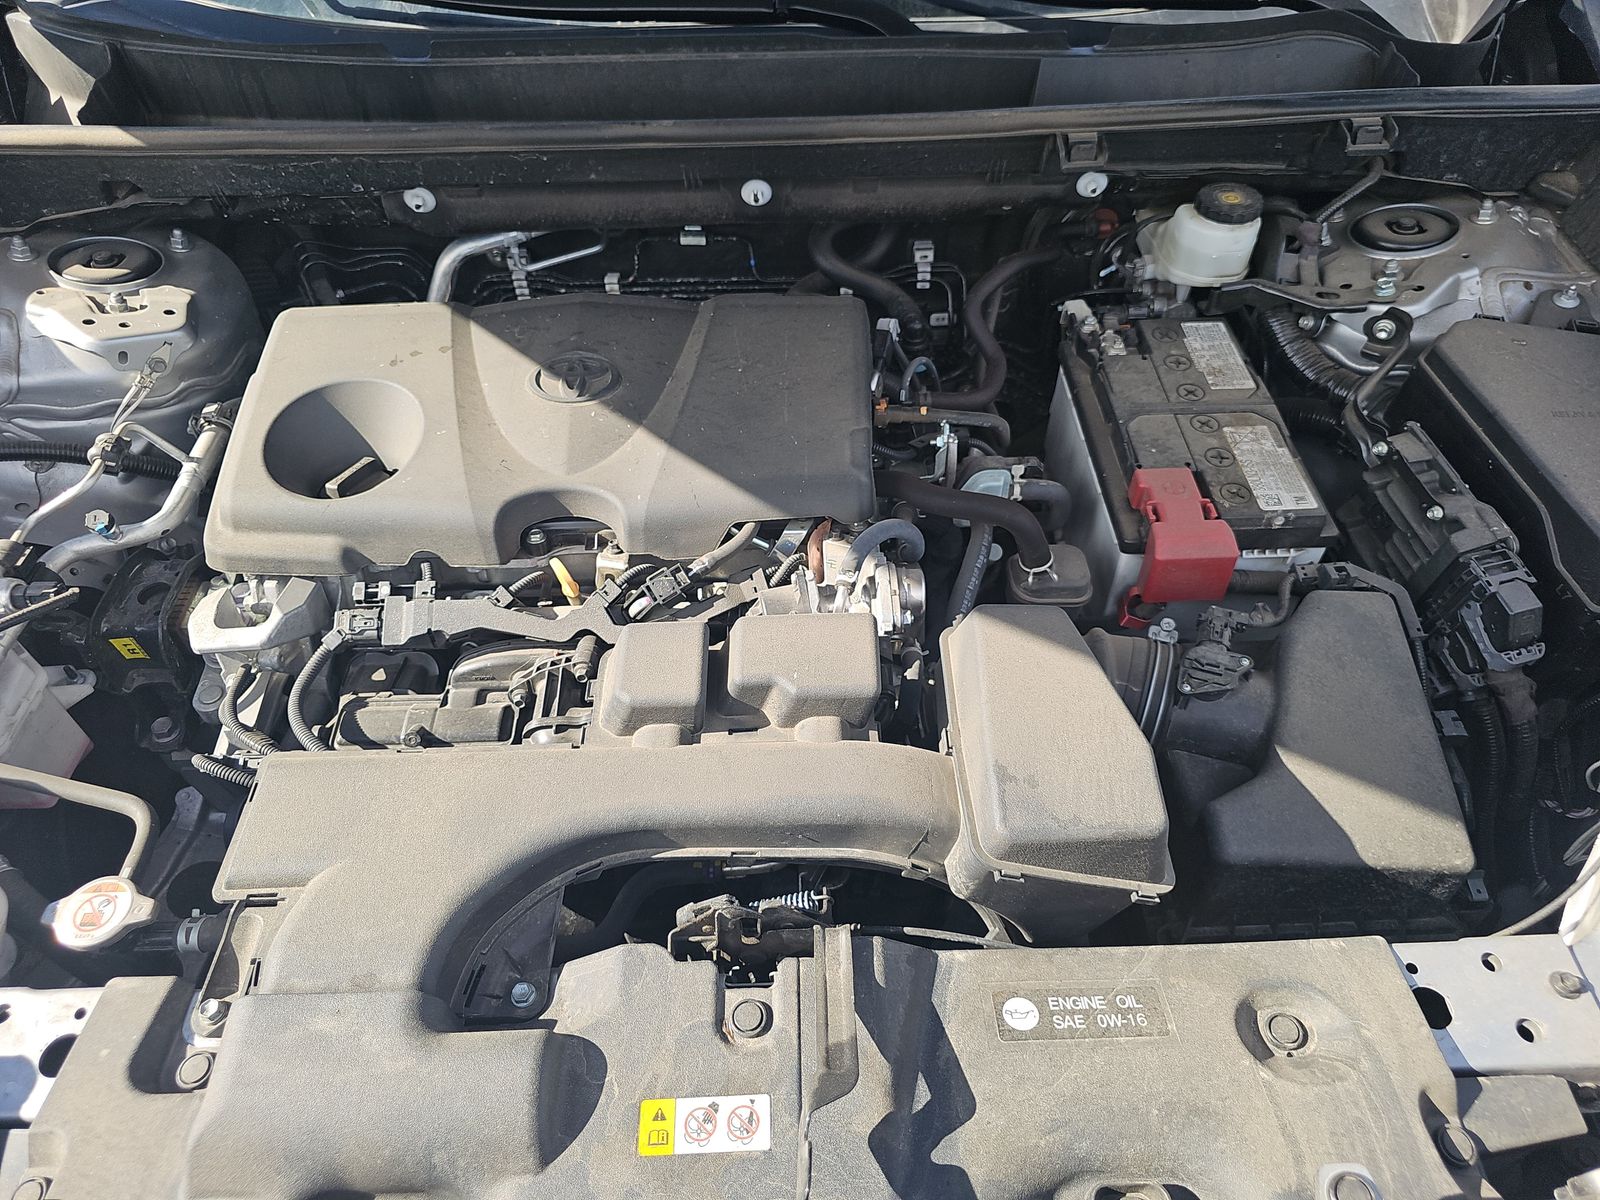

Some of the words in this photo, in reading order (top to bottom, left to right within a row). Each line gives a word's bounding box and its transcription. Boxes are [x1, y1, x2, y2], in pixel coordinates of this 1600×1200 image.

[1048, 995, 1107, 1011] ENGINE
[1115, 994, 1144, 1009] OIL
[1053, 1015, 1086, 1030] SAE
[1097, 1013, 1148, 1028] 0W-16
